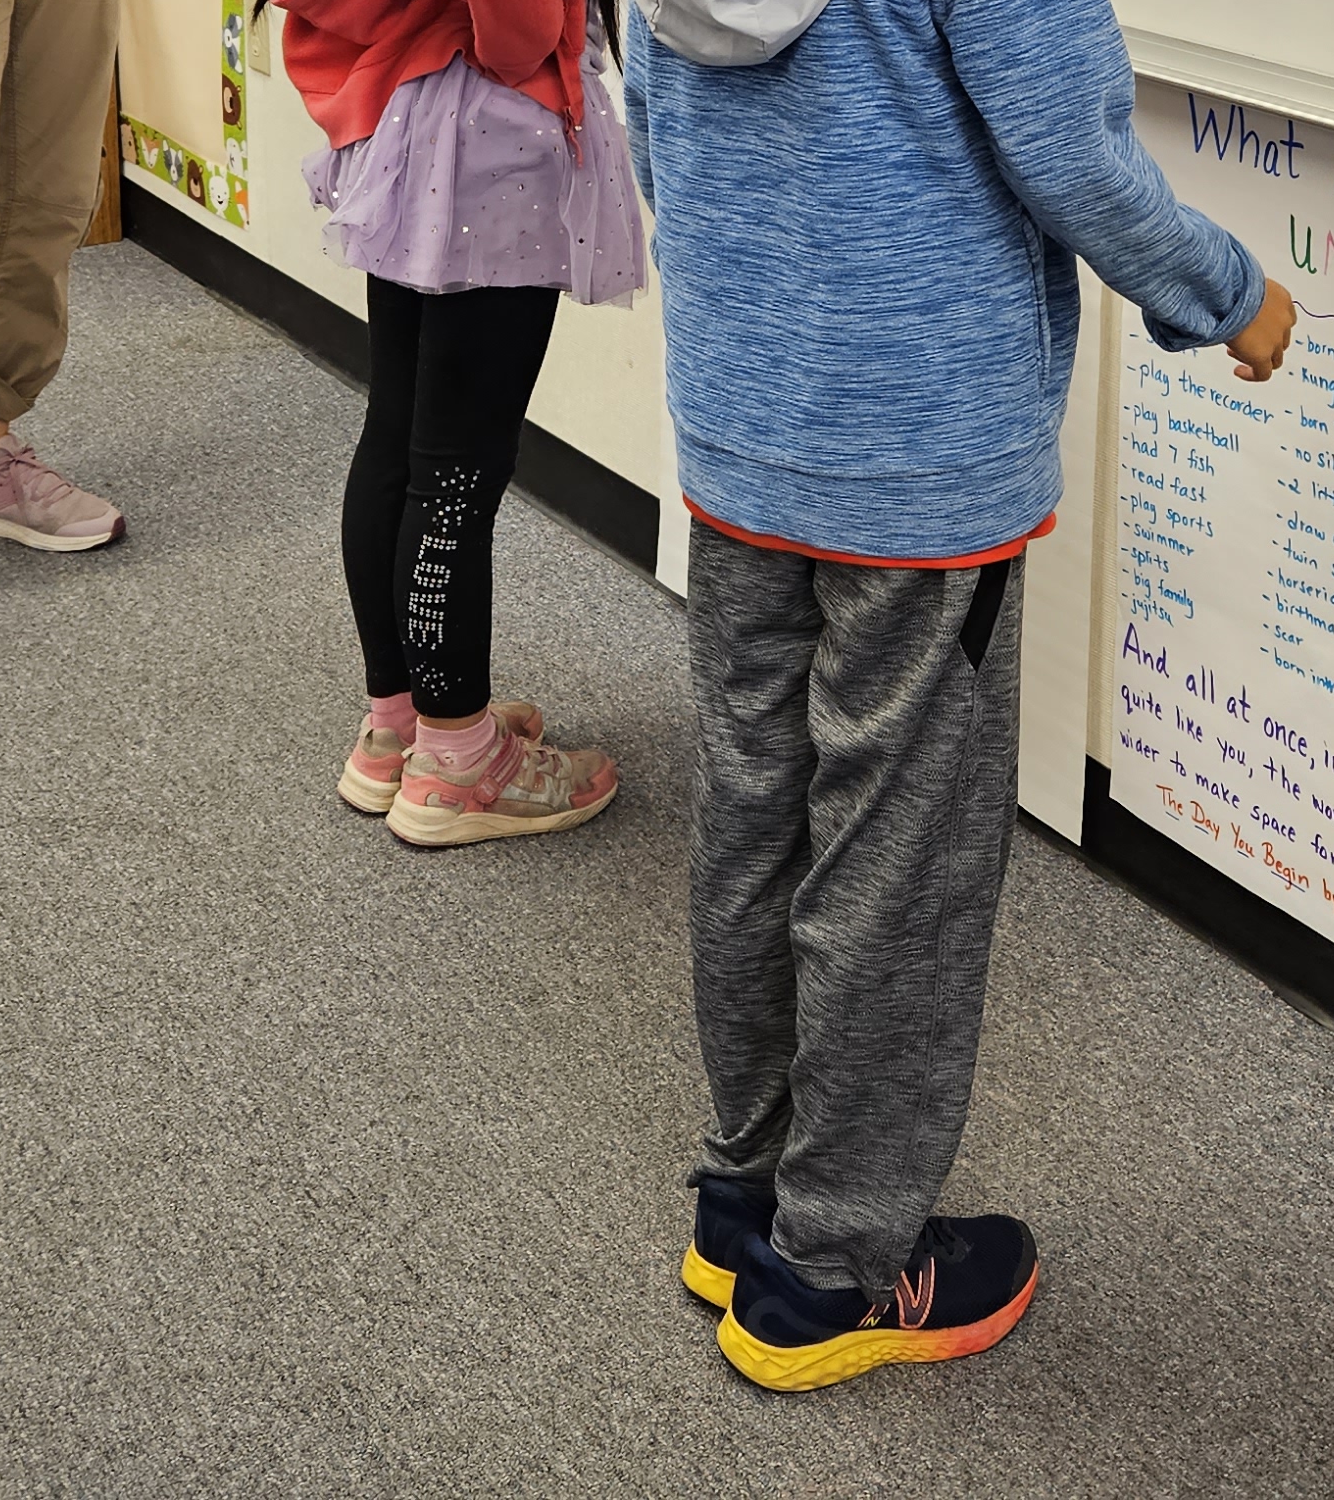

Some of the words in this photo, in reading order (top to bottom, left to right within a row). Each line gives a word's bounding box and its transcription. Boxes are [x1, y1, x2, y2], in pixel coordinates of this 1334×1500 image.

[1187, 92, 1304, 179] What
[1178, 369, 1207, 399] the
[1210, 388, 1274, 424] recorder
[1168, 410, 1240, 452] basketball
[1300, 405, 1329, 434] born
[1187, 448, 1215, 476] fish
[1295, 447, 1312, 463] no
[1131, 467, 1164, 491] read
[1170, 477, 1207, 503] fast
[1166, 508, 1214, 538] sports
[1157, 579, 1194, 620] family
[1123, 622, 1169, 678] And
[1185, 665, 1215, 704] all
[1226, 685, 1251, 723] at
[1264, 717, 1315, 770] once,
[1121, 685, 1162, 722] quite
[1175, 705, 1203, 743] like
[1216, 737, 1254, 779] you,
[1263, 756, 1302, 801] the
[1119, 729, 1160, 763] wider
[1170, 751, 1187, 777] to
[1195, 772, 1241, 810] make
[1250, 805, 1296, 843] space
[1155, 784, 1184, 817] The
[1190, 800, 1220, 841] Day
[1231, 822, 1255, 858] You
[1261, 841, 1310, 890] Begin
